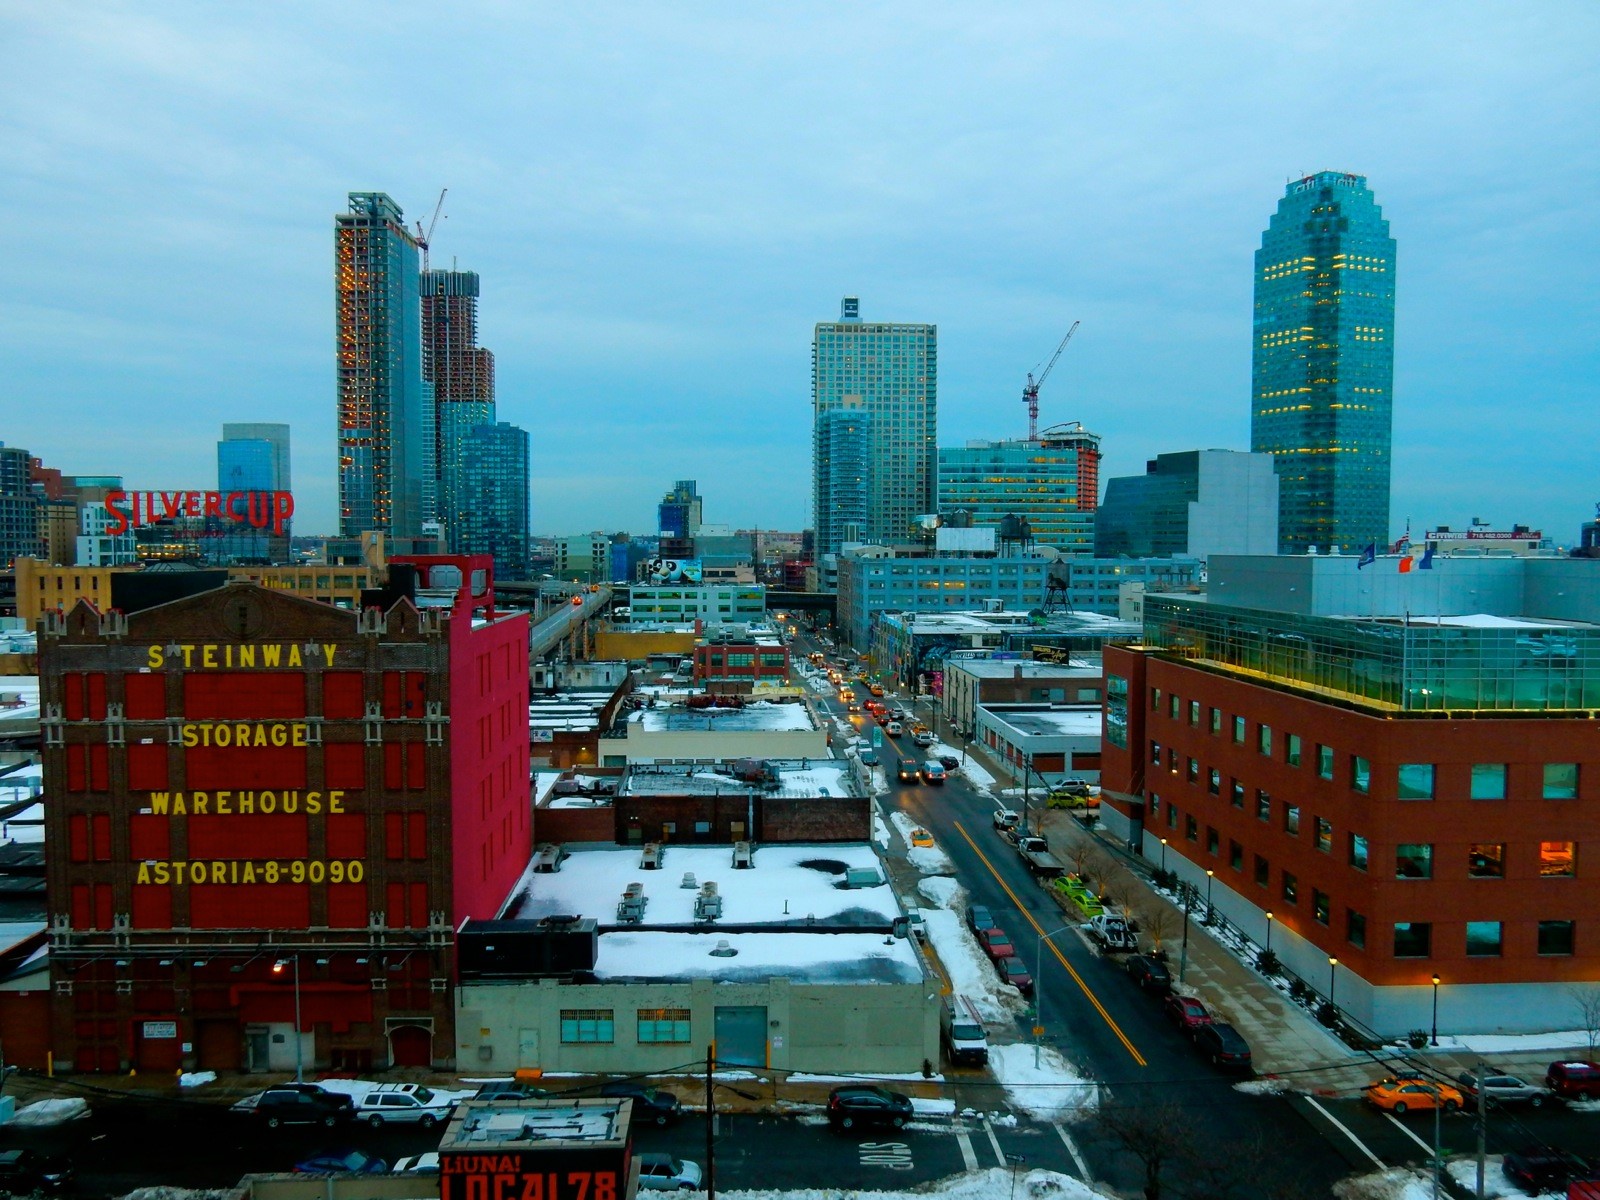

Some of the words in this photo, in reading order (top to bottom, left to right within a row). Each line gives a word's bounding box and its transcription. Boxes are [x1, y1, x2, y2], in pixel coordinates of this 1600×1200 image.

[105, 490, 294, 536] SILVERCUP
[148, 644, 337, 668] STEINWAY
[182, 724, 307, 747] STORAGE
[151, 790, 345, 815] WAREHOUSE
[136, 860, 364, 885] ASTORIA-8-9090
[858, 1142, 914, 1170] STOP
[568, 1171, 617, 1200] 78
